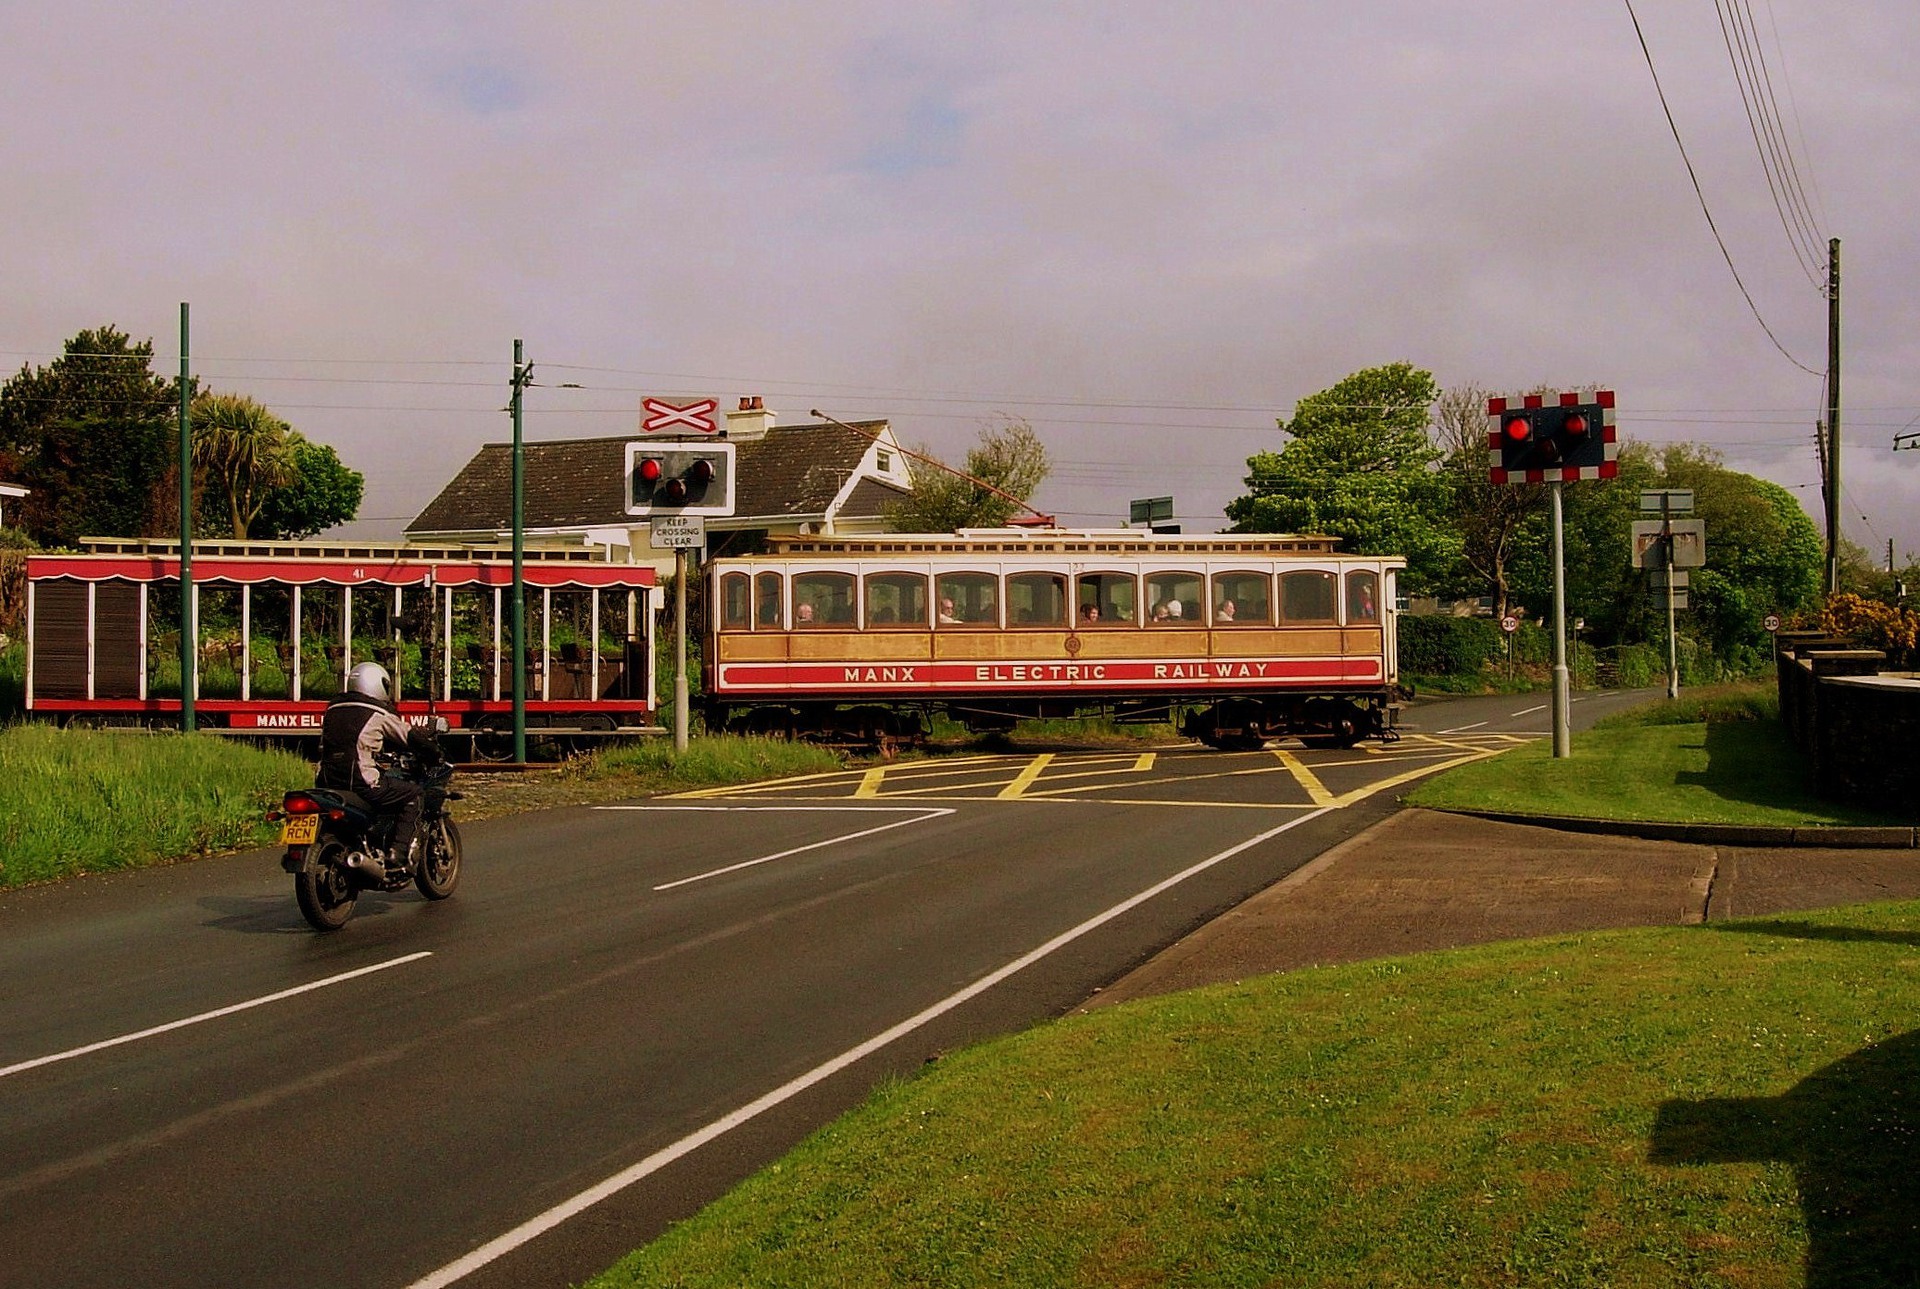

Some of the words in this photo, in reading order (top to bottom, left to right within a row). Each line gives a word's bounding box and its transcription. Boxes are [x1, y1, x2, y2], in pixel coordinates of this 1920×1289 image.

[666, 517, 688, 526] KEEP
[656, 527, 700, 536] CROSSING
[663, 537, 692, 546] CLEAR
[352, 568, 365, 579] 41
[1503, 620, 1516, 628] 30
[1765, 618, 1778, 627] 30
[844, 666, 915, 682] MANX
[975, 665, 1106, 681] ELECTRIC
[1153, 662, 1268, 679] RAILWAY
[256, 714, 298, 727] MANX
[286, 827, 312, 839] RCN
